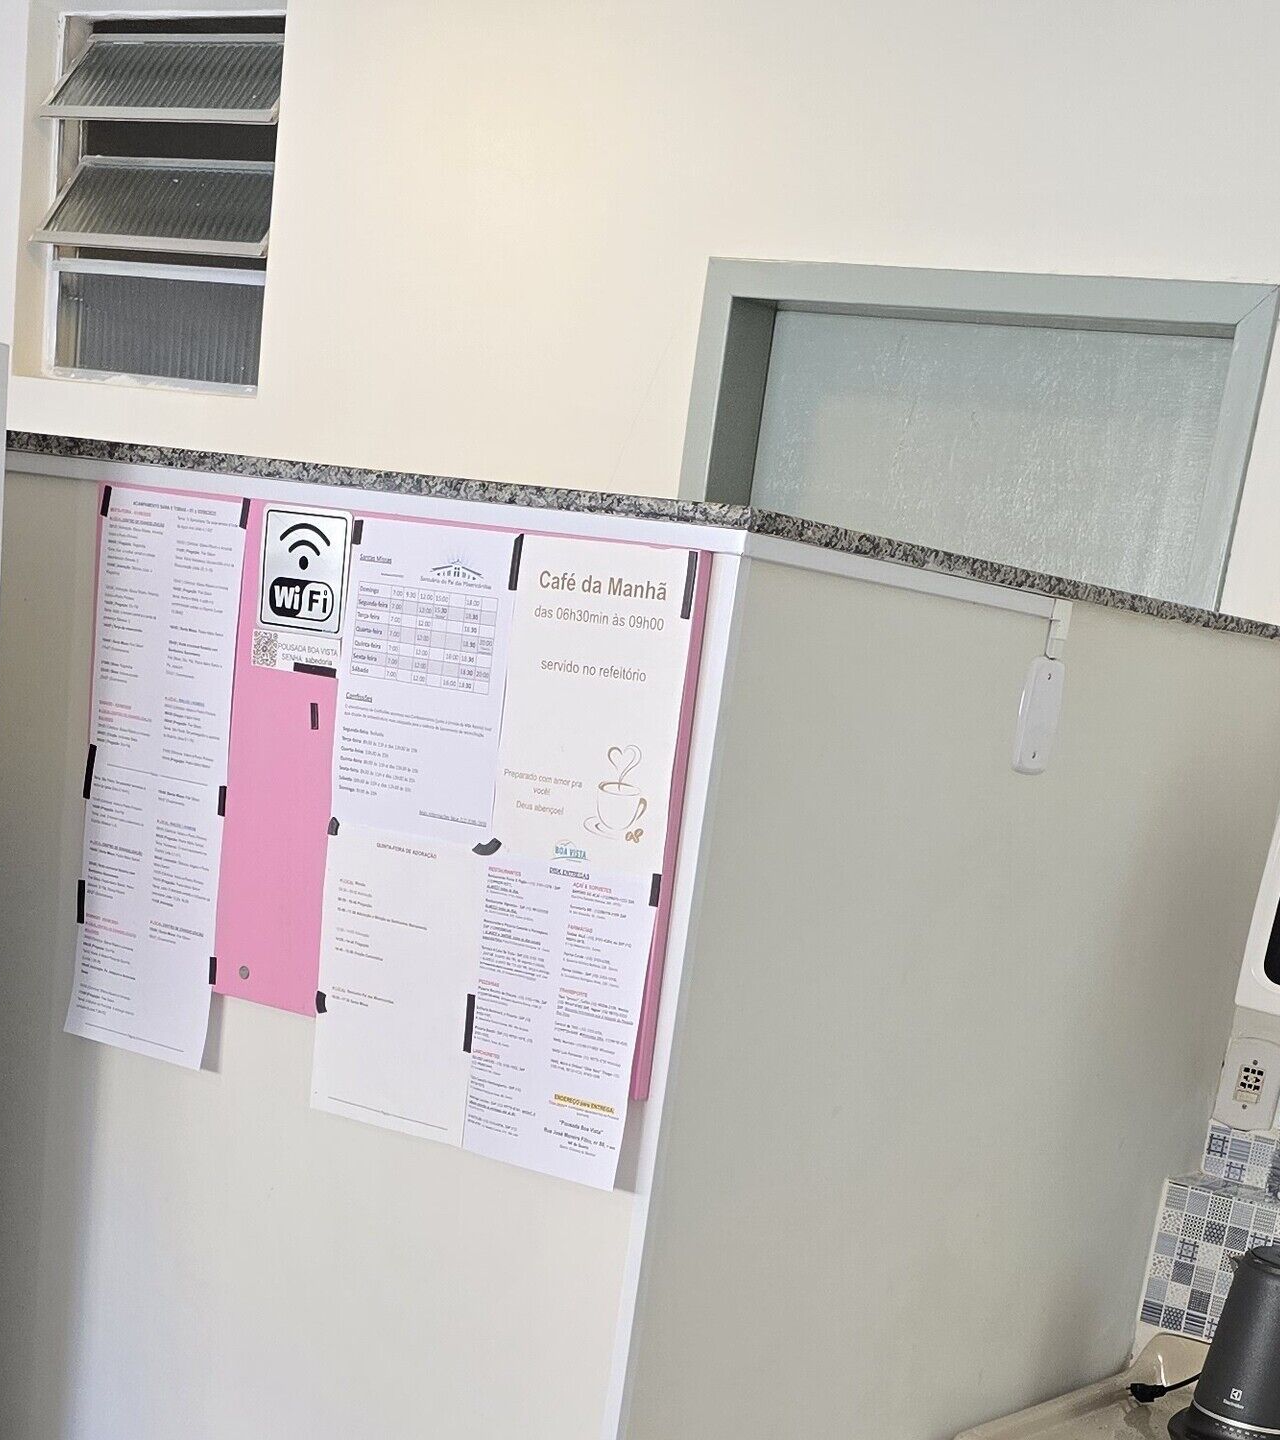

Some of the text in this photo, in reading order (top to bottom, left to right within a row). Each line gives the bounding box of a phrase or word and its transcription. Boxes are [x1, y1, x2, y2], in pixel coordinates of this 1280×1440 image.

[539, 570, 667, 600] Café da Manhã
[534, 605, 664, 631] das 06h30min às 09h00
[278, 643, 338, 656] POUSADA BOA VISTA
[540, 659, 647, 682] servido no refeitório
[504, 768, 583, 790] Preparado com amor pra
[516, 800, 533, 811] Deus
[569, 848, 587, 860] VISTA
